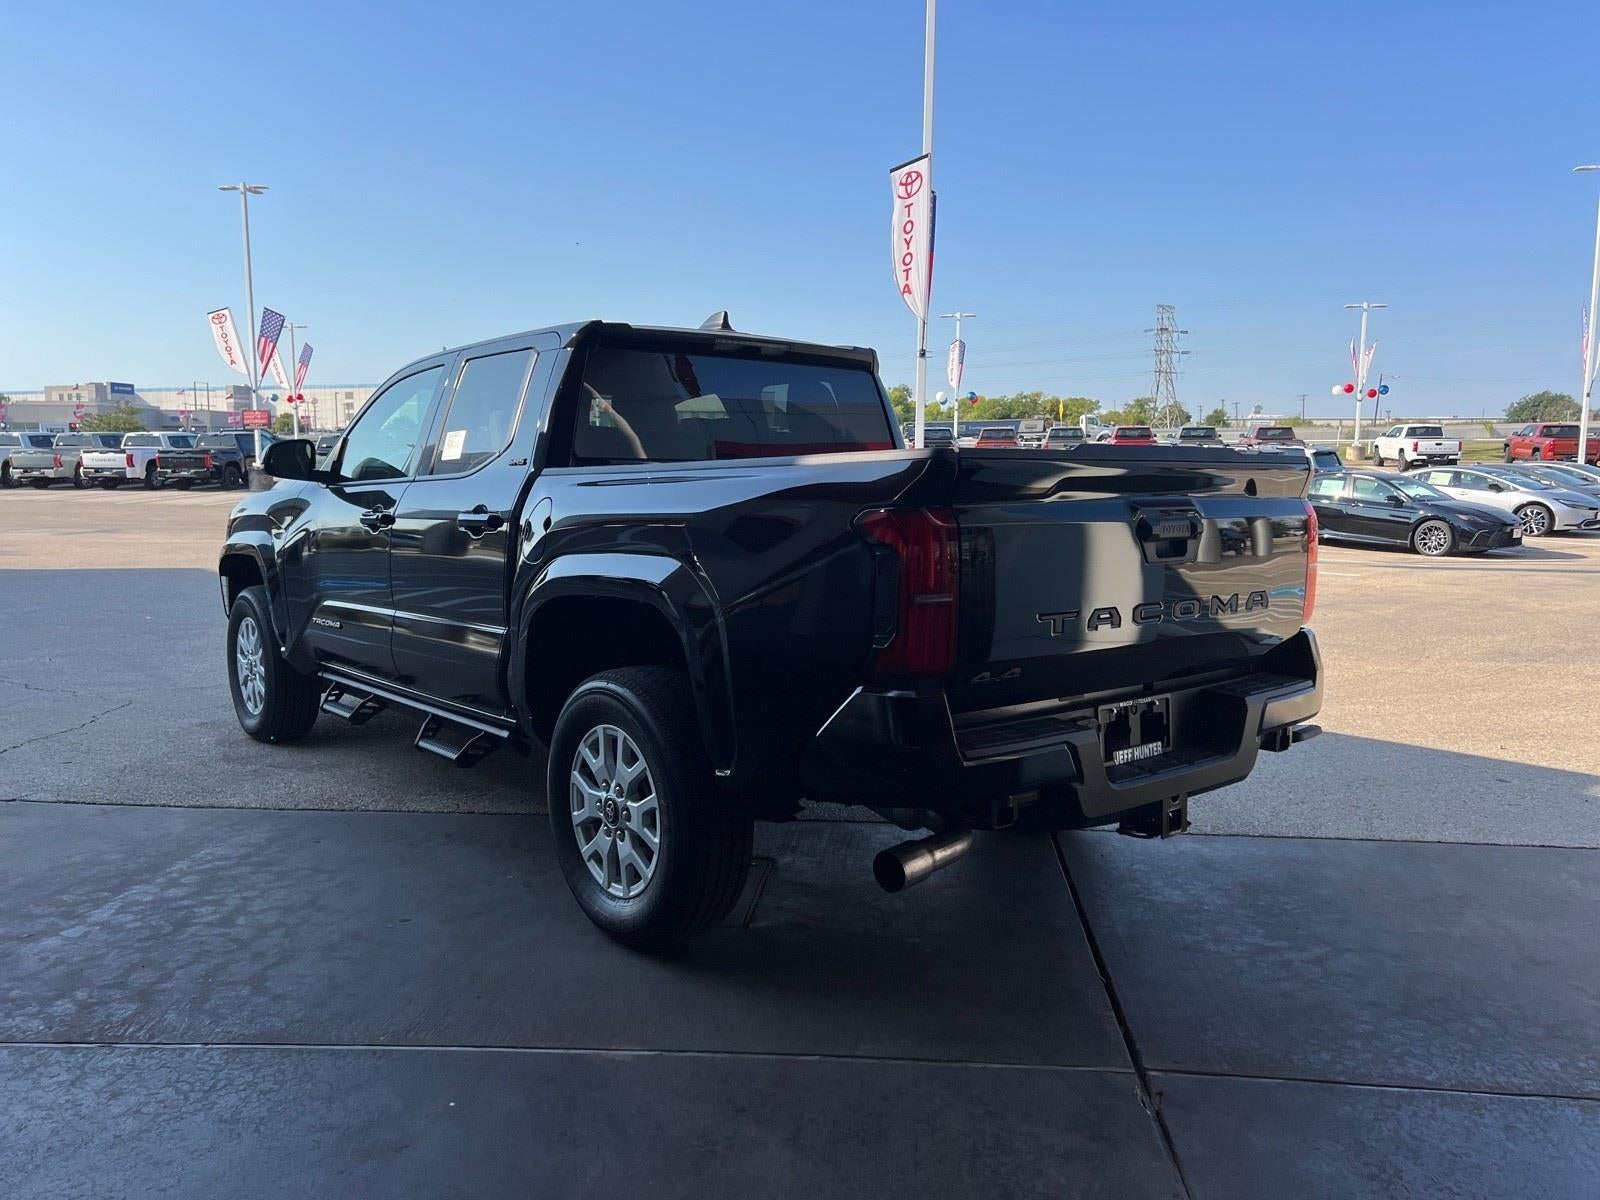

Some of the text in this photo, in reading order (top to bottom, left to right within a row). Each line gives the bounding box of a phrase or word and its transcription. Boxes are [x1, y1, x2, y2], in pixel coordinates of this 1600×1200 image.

[902, 203, 914, 295] TOYOTA
[220, 325, 237, 366] TOYOTA
[1162, 524, 1190, 535] TOYOTA
[312, 617, 341, 629] TACOMA
[1037, 590, 1269, 637] TACOMA
[1113, 741, 1162, 766] JEFF HUNTER
